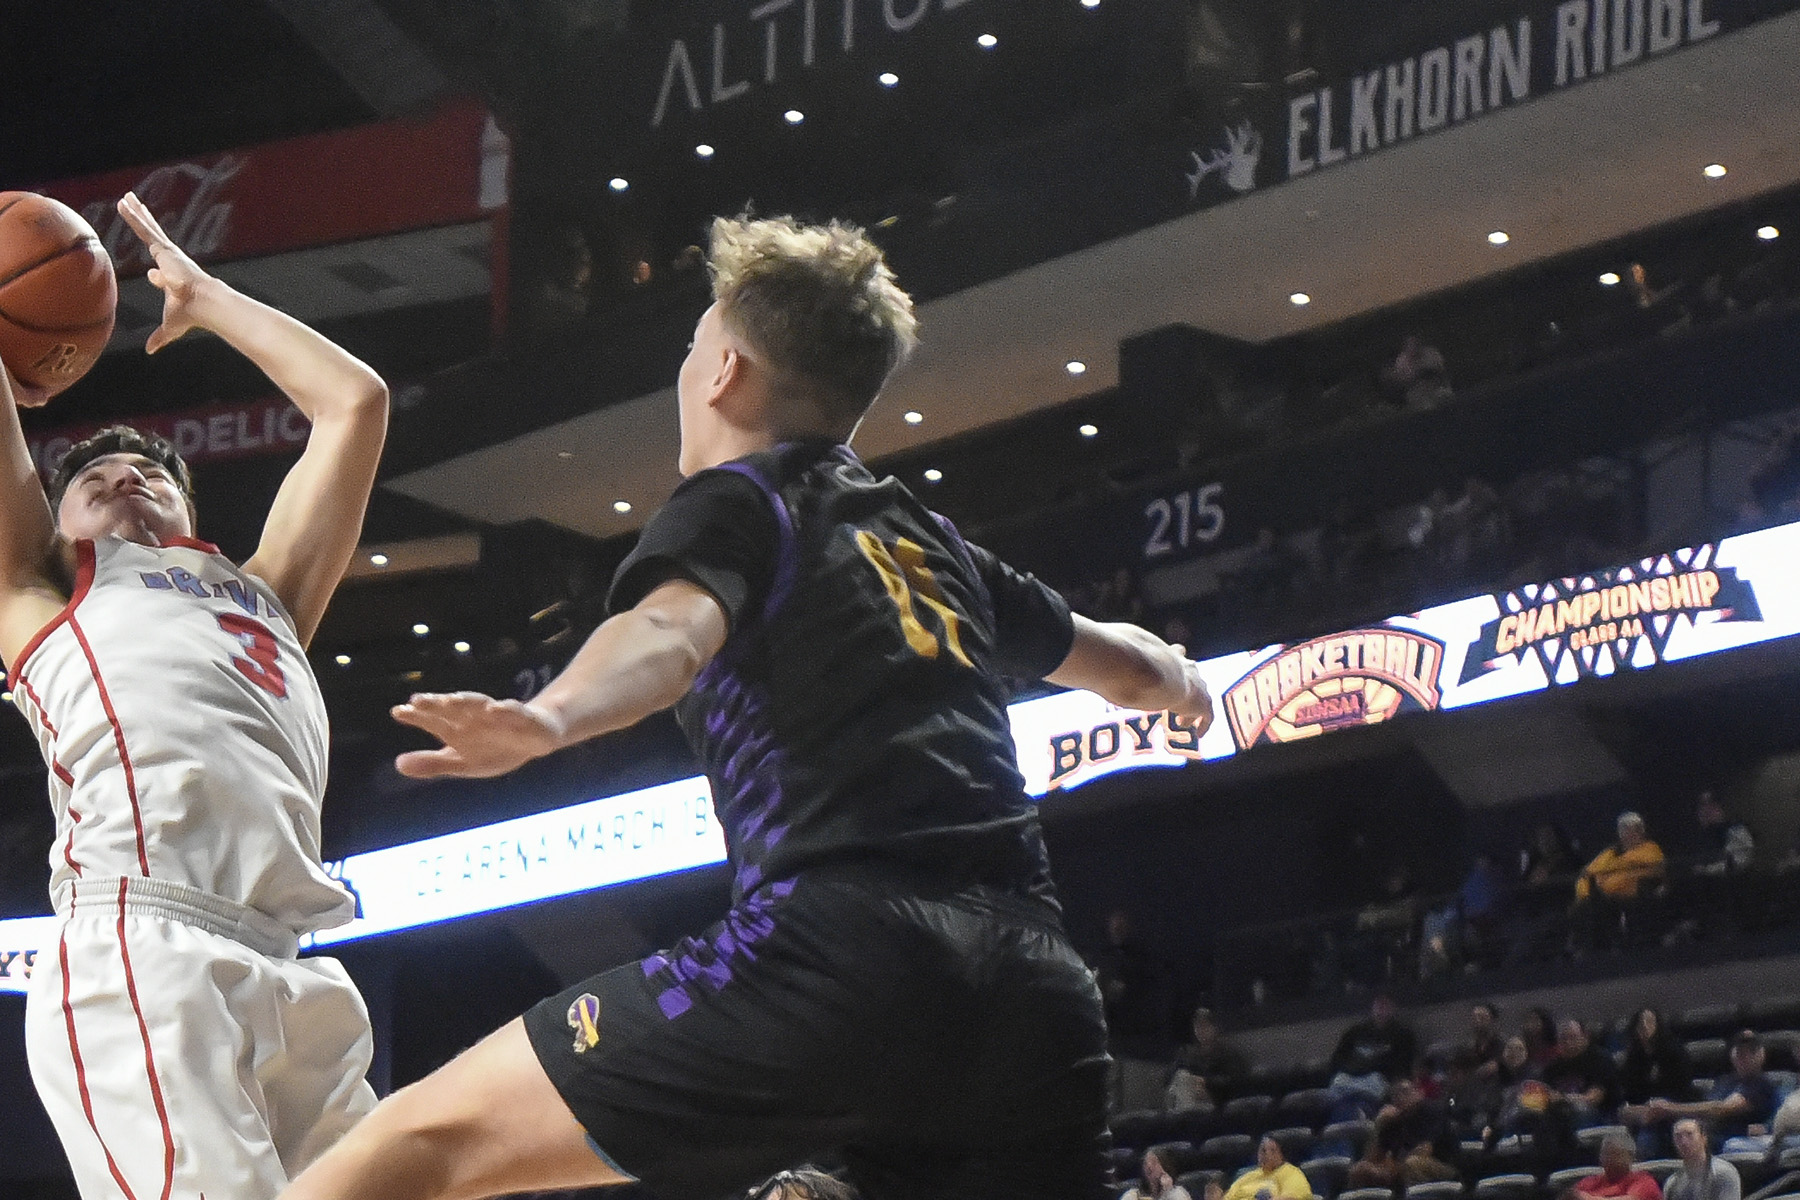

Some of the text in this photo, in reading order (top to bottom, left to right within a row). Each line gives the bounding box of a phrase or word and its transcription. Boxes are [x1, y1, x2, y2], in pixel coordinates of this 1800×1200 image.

[1288, 17, 1533, 177] ELKHORN
[1145, 483, 1224, 556] 215
[1496, 570, 1721, 653] CHAMPIONSHIP
[216, 611, 289, 701] 3
[1233, 633, 1438, 738] BASKETBALL
[1050, 710, 1200, 785] BOYS
[566, 806, 668, 856] MARCH
